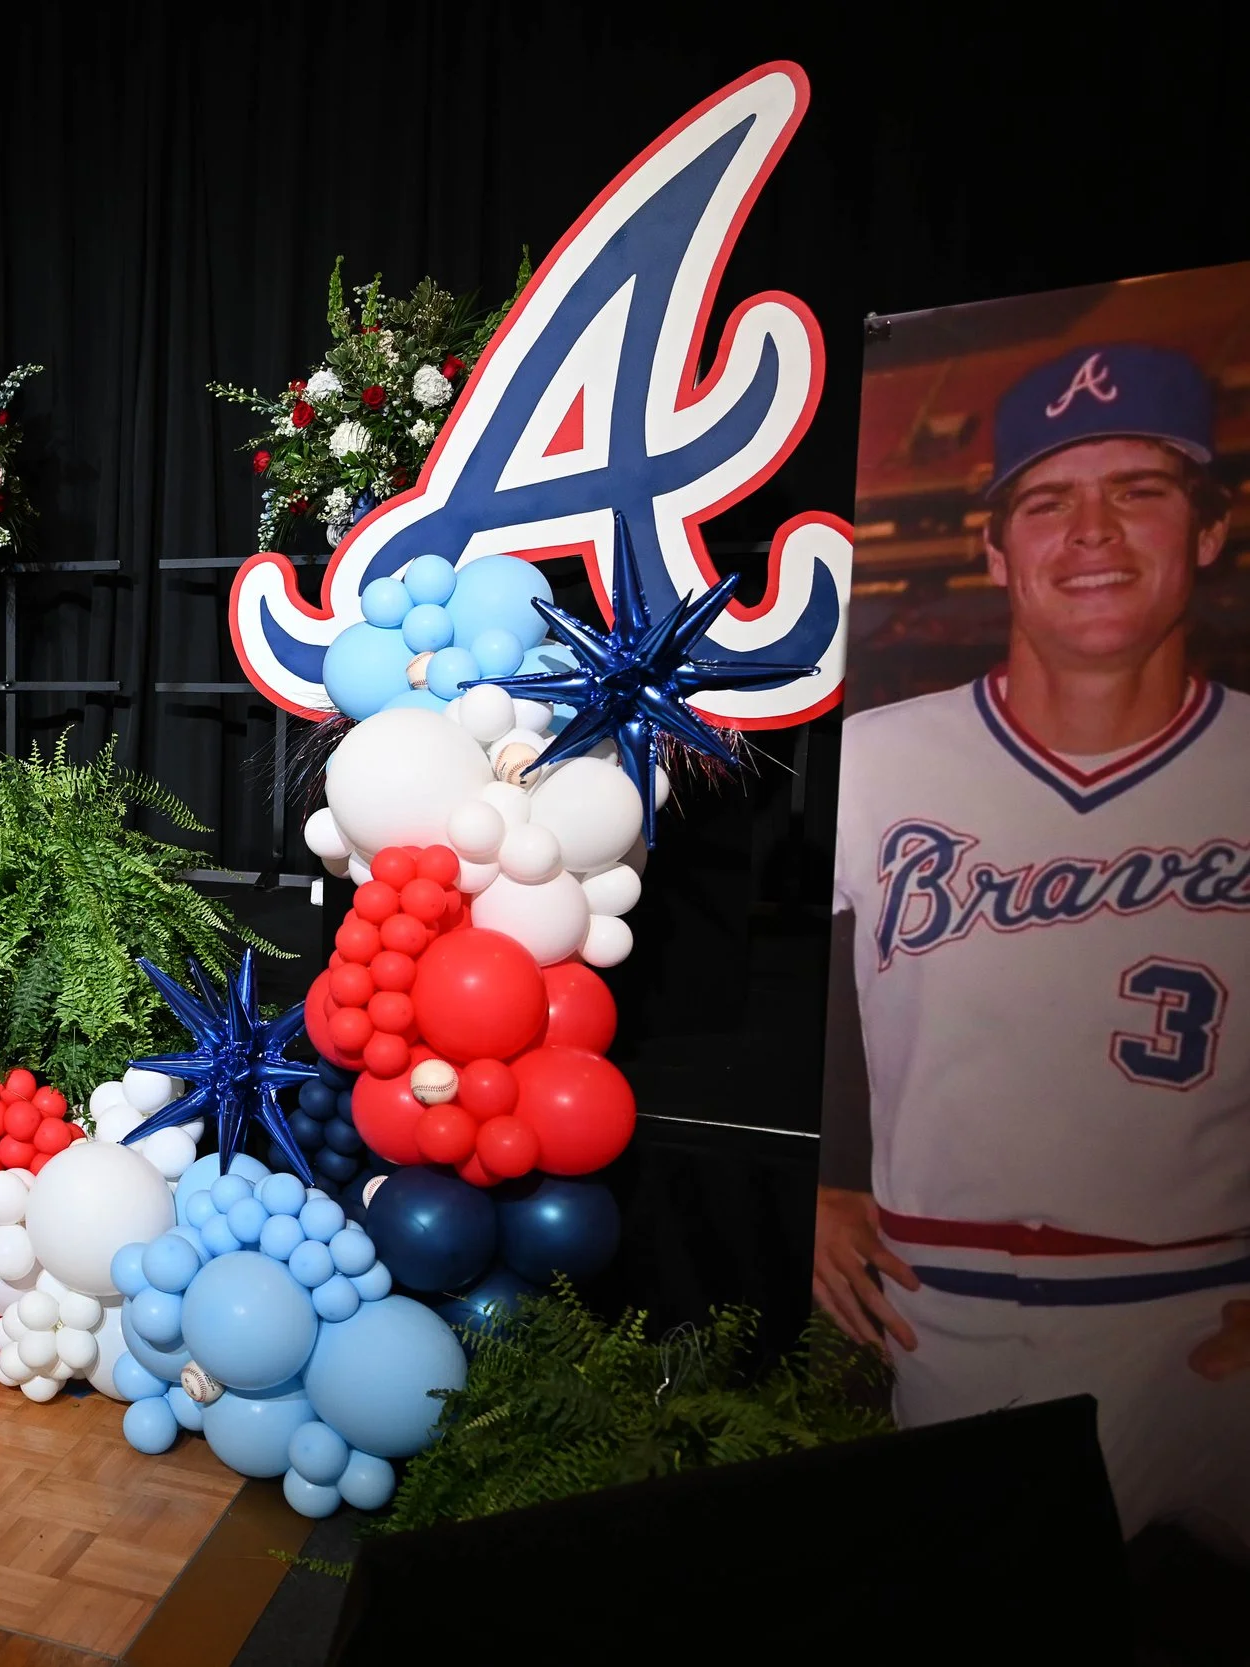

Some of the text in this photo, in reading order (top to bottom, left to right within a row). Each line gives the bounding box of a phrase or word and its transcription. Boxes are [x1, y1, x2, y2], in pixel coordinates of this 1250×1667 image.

[229, 60, 853, 730] A
[1045, 352, 1117, 418] A
[1109, 955, 1229, 1092] 3
